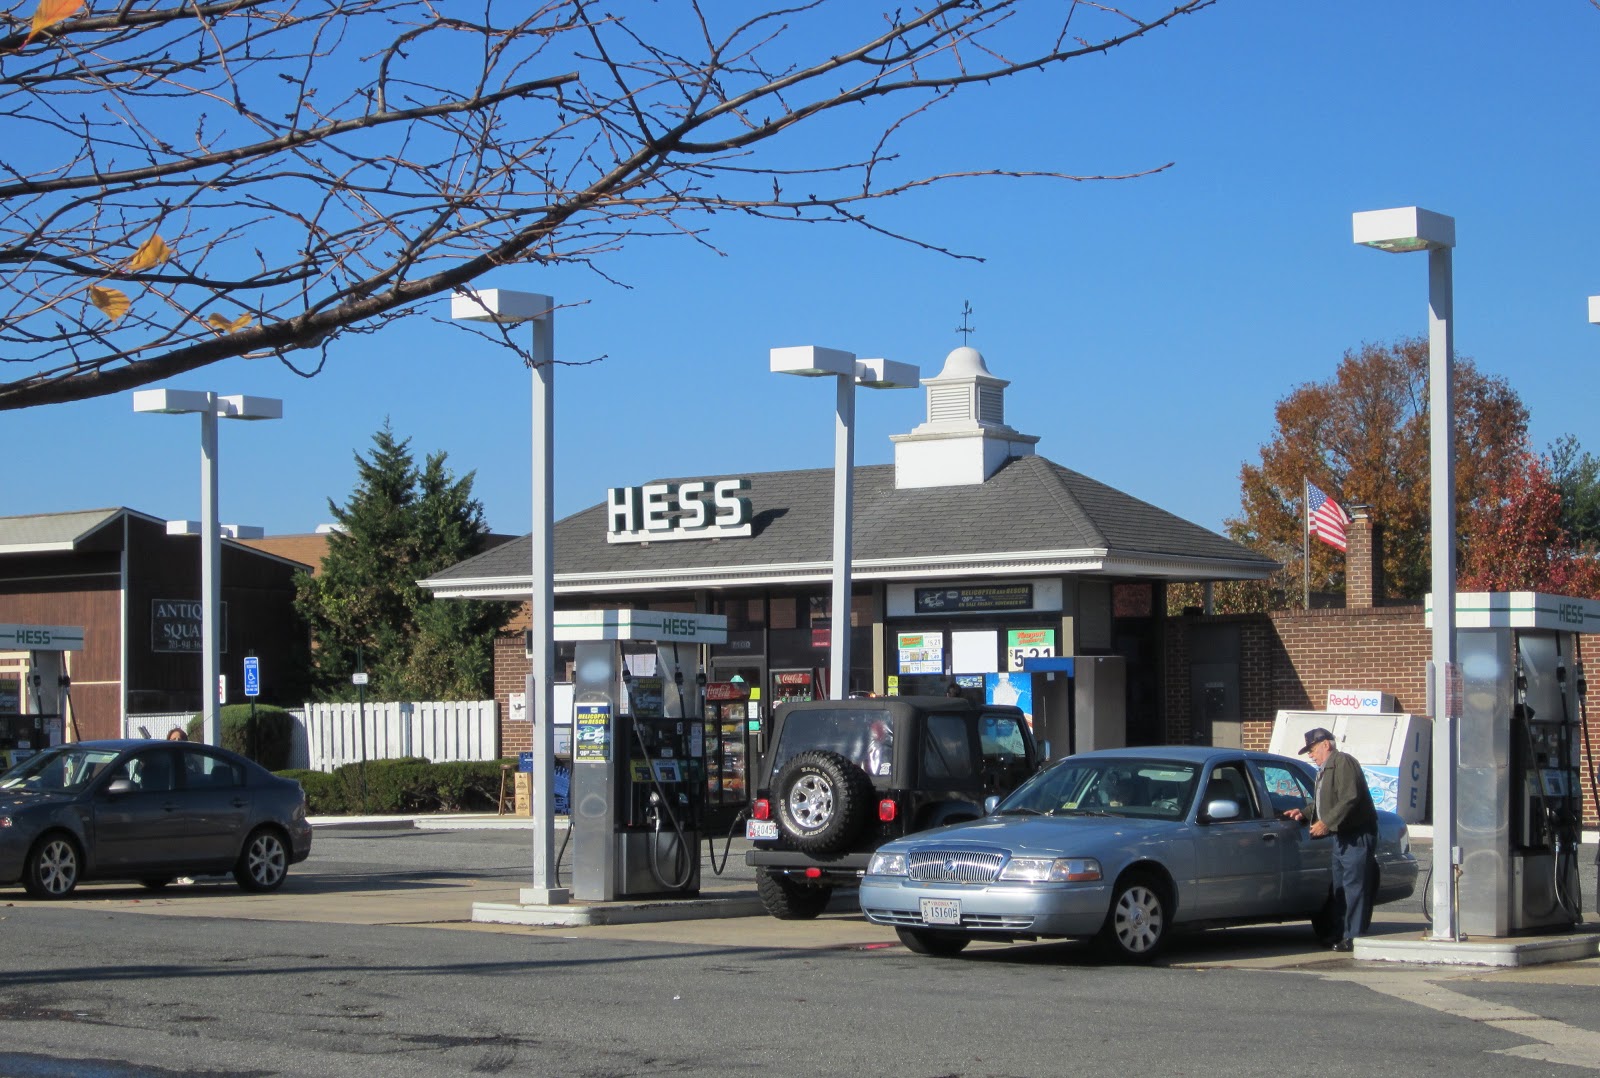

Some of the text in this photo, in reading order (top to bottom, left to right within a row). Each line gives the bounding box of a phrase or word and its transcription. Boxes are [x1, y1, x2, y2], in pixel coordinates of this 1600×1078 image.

[607, 479, 746, 532] HESS
[156, 603, 203, 621] ANTIQ
[1559, 603, 1584, 624] HESS
[163, 623, 202, 640] SQUA
[663, 618, 696, 636] HESS
[16, 630, 51, 644] HESS
[783, 673, 803, 684] Coca-Cola
